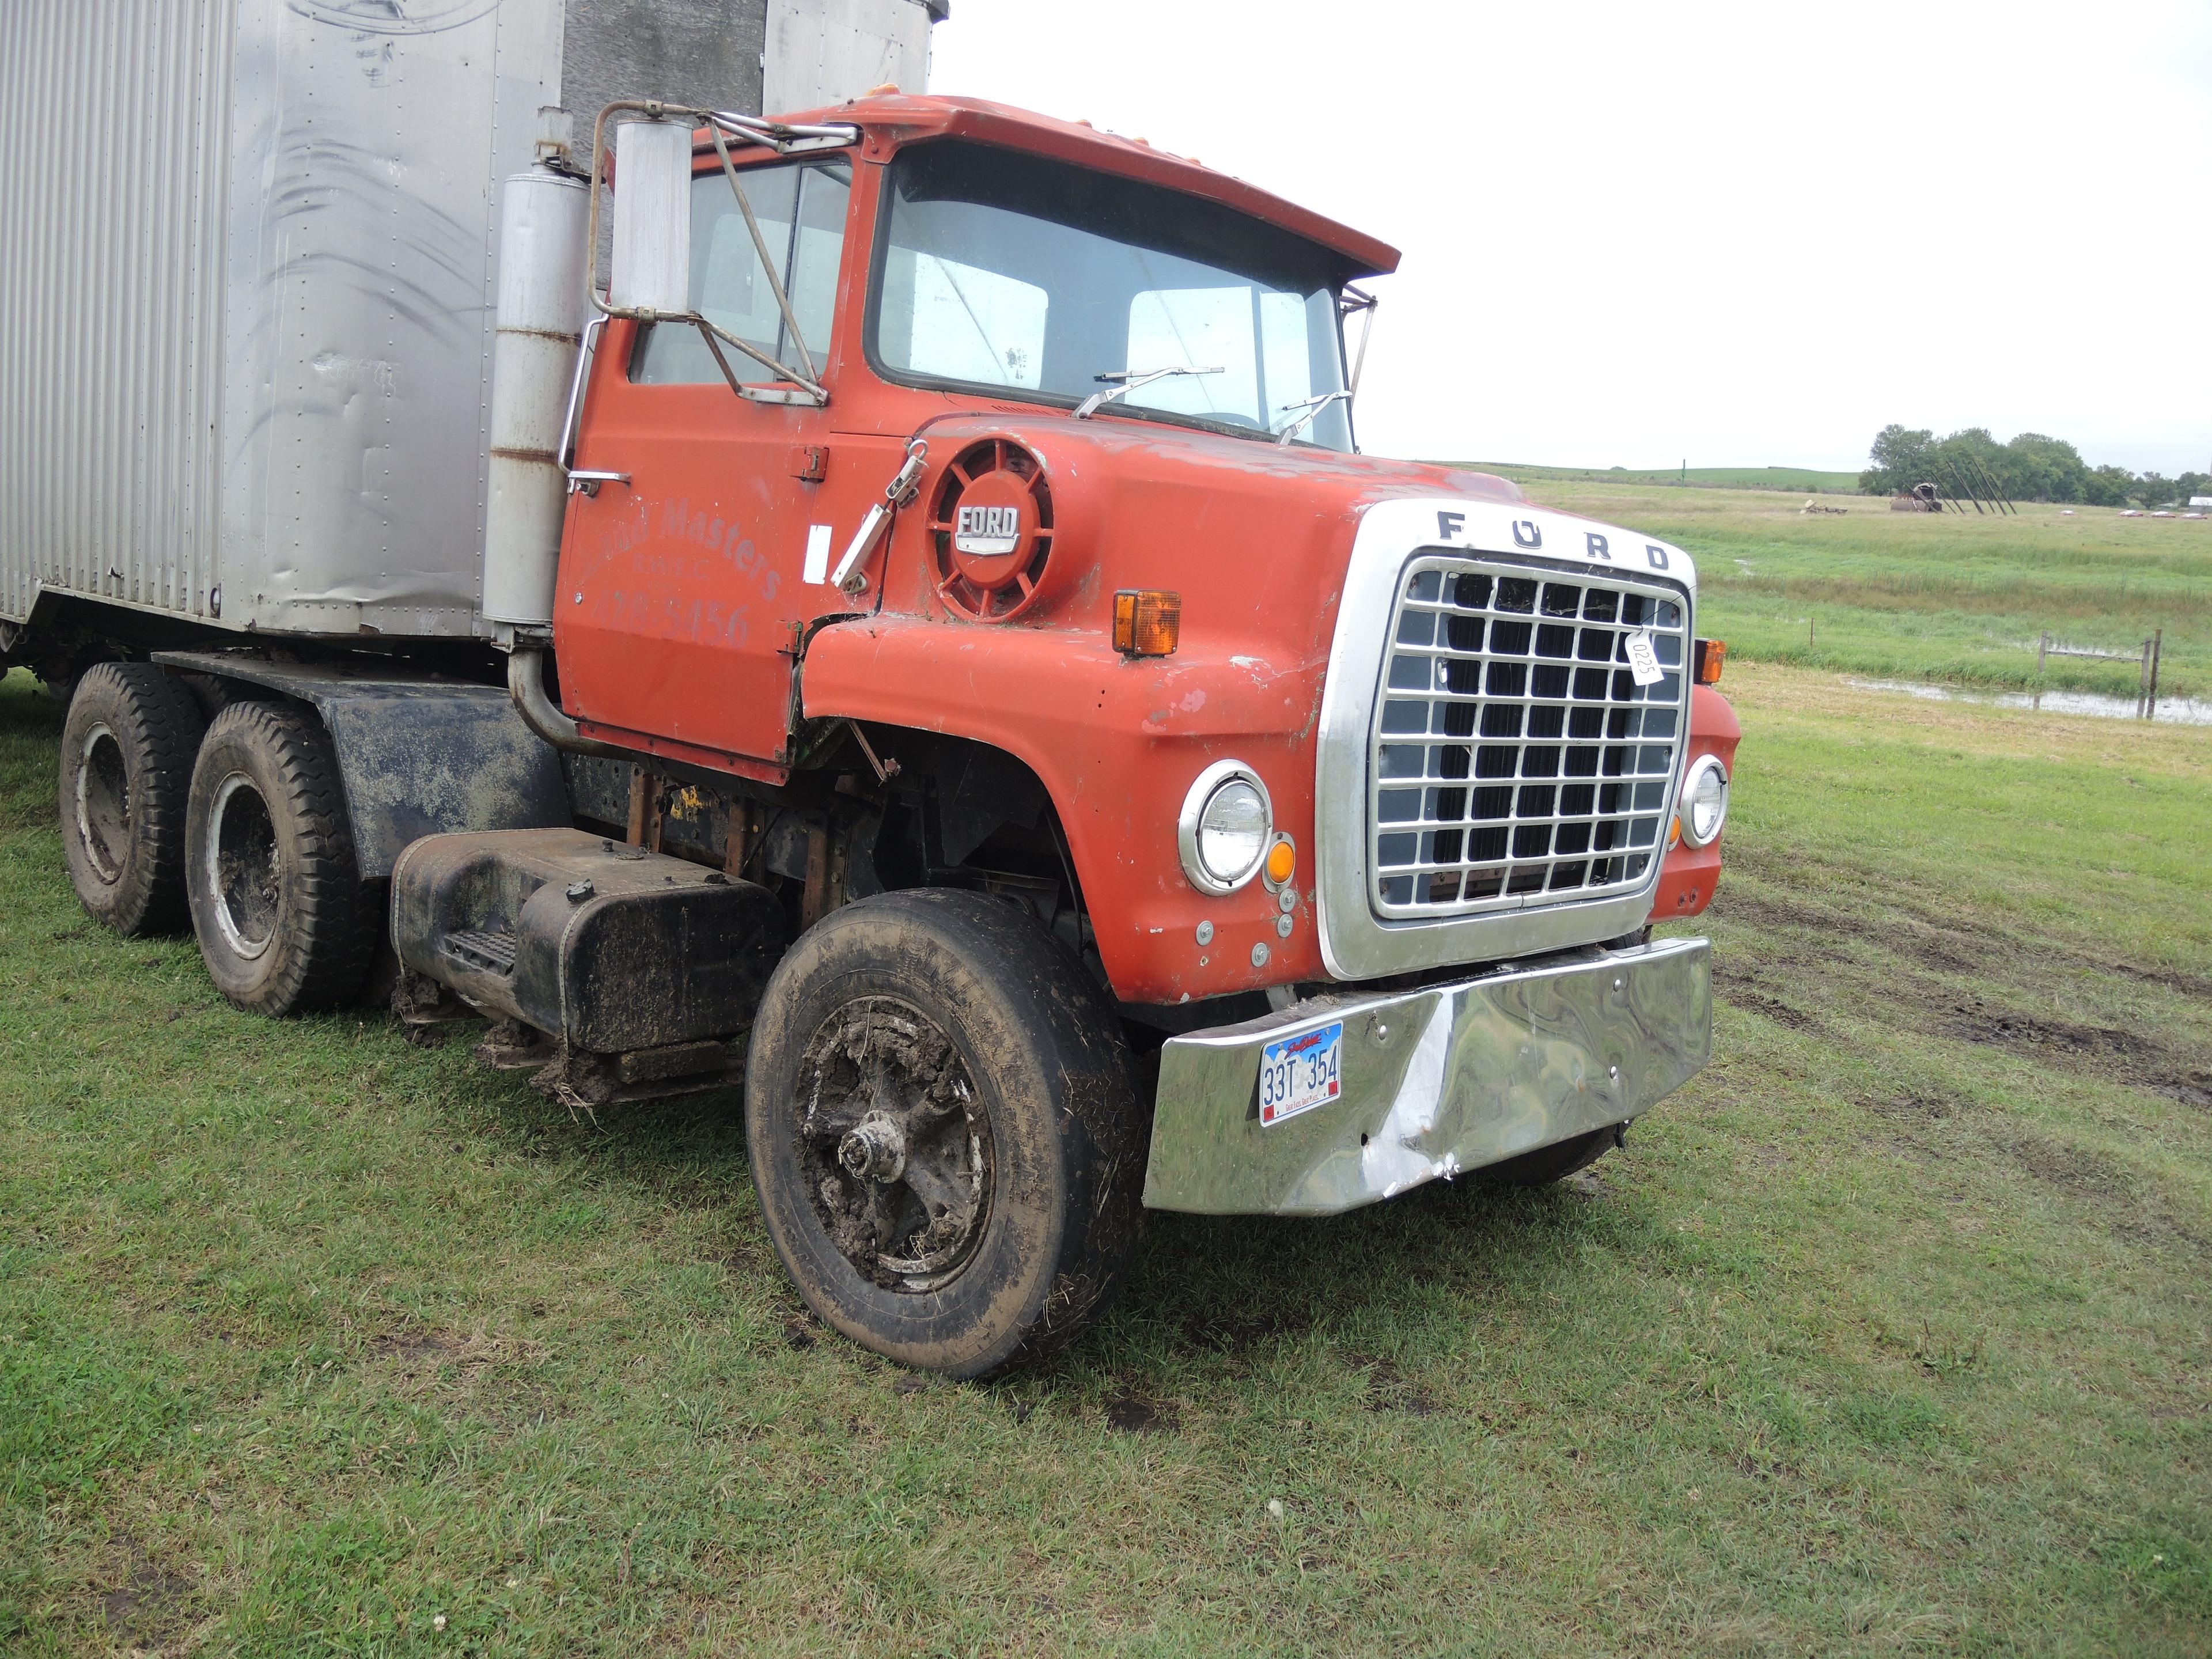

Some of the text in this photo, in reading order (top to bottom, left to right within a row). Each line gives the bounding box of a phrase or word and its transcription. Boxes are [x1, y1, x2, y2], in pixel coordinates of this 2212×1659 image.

[661, 497, 782, 601] Masters
[957, 506, 1019, 537] FORD
[1437, 511, 1669, 570] FORD
[1633, 645, 1655, 673] 0225
[1264, 1045, 1337, 1105] 33T 354
